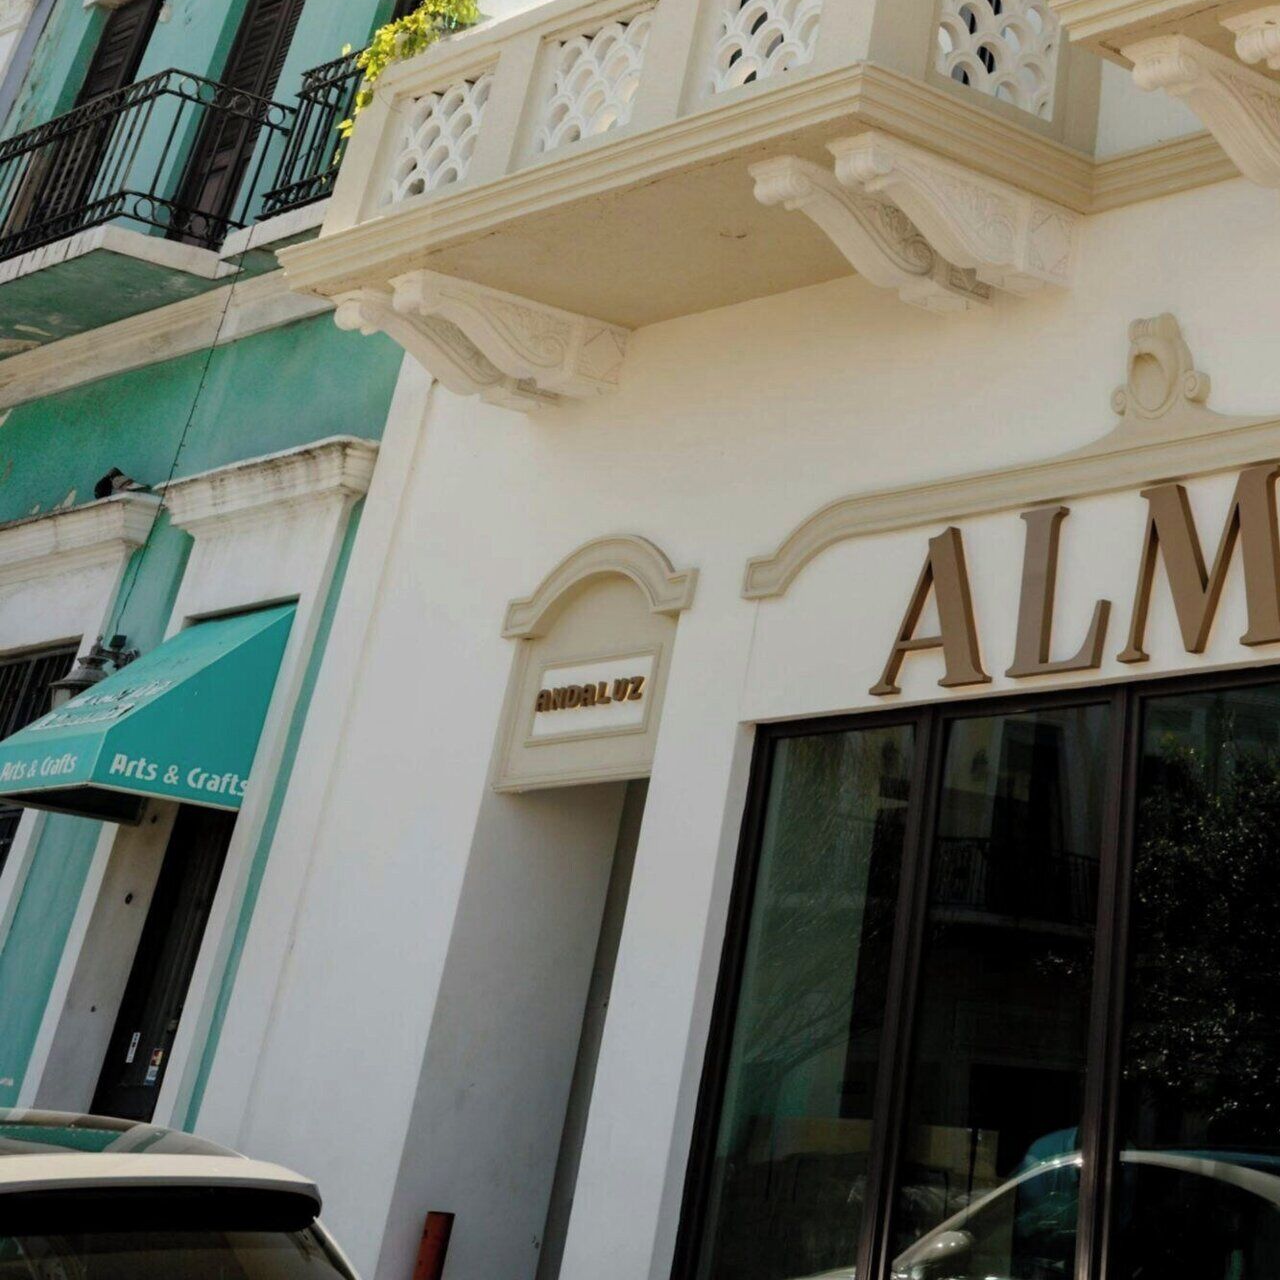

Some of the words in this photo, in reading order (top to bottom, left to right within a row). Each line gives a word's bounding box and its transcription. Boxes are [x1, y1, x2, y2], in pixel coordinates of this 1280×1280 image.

[535, 675, 646, 713] ANDALUZ
[0, 760, 28, 781] Arts
[27, 759, 38, 779] &
[40, 752, 78, 777] Crafts
[109, 752, 159, 781] Arts
[163, 764, 180, 786] &
[186, 766, 249, 797] Crafts
